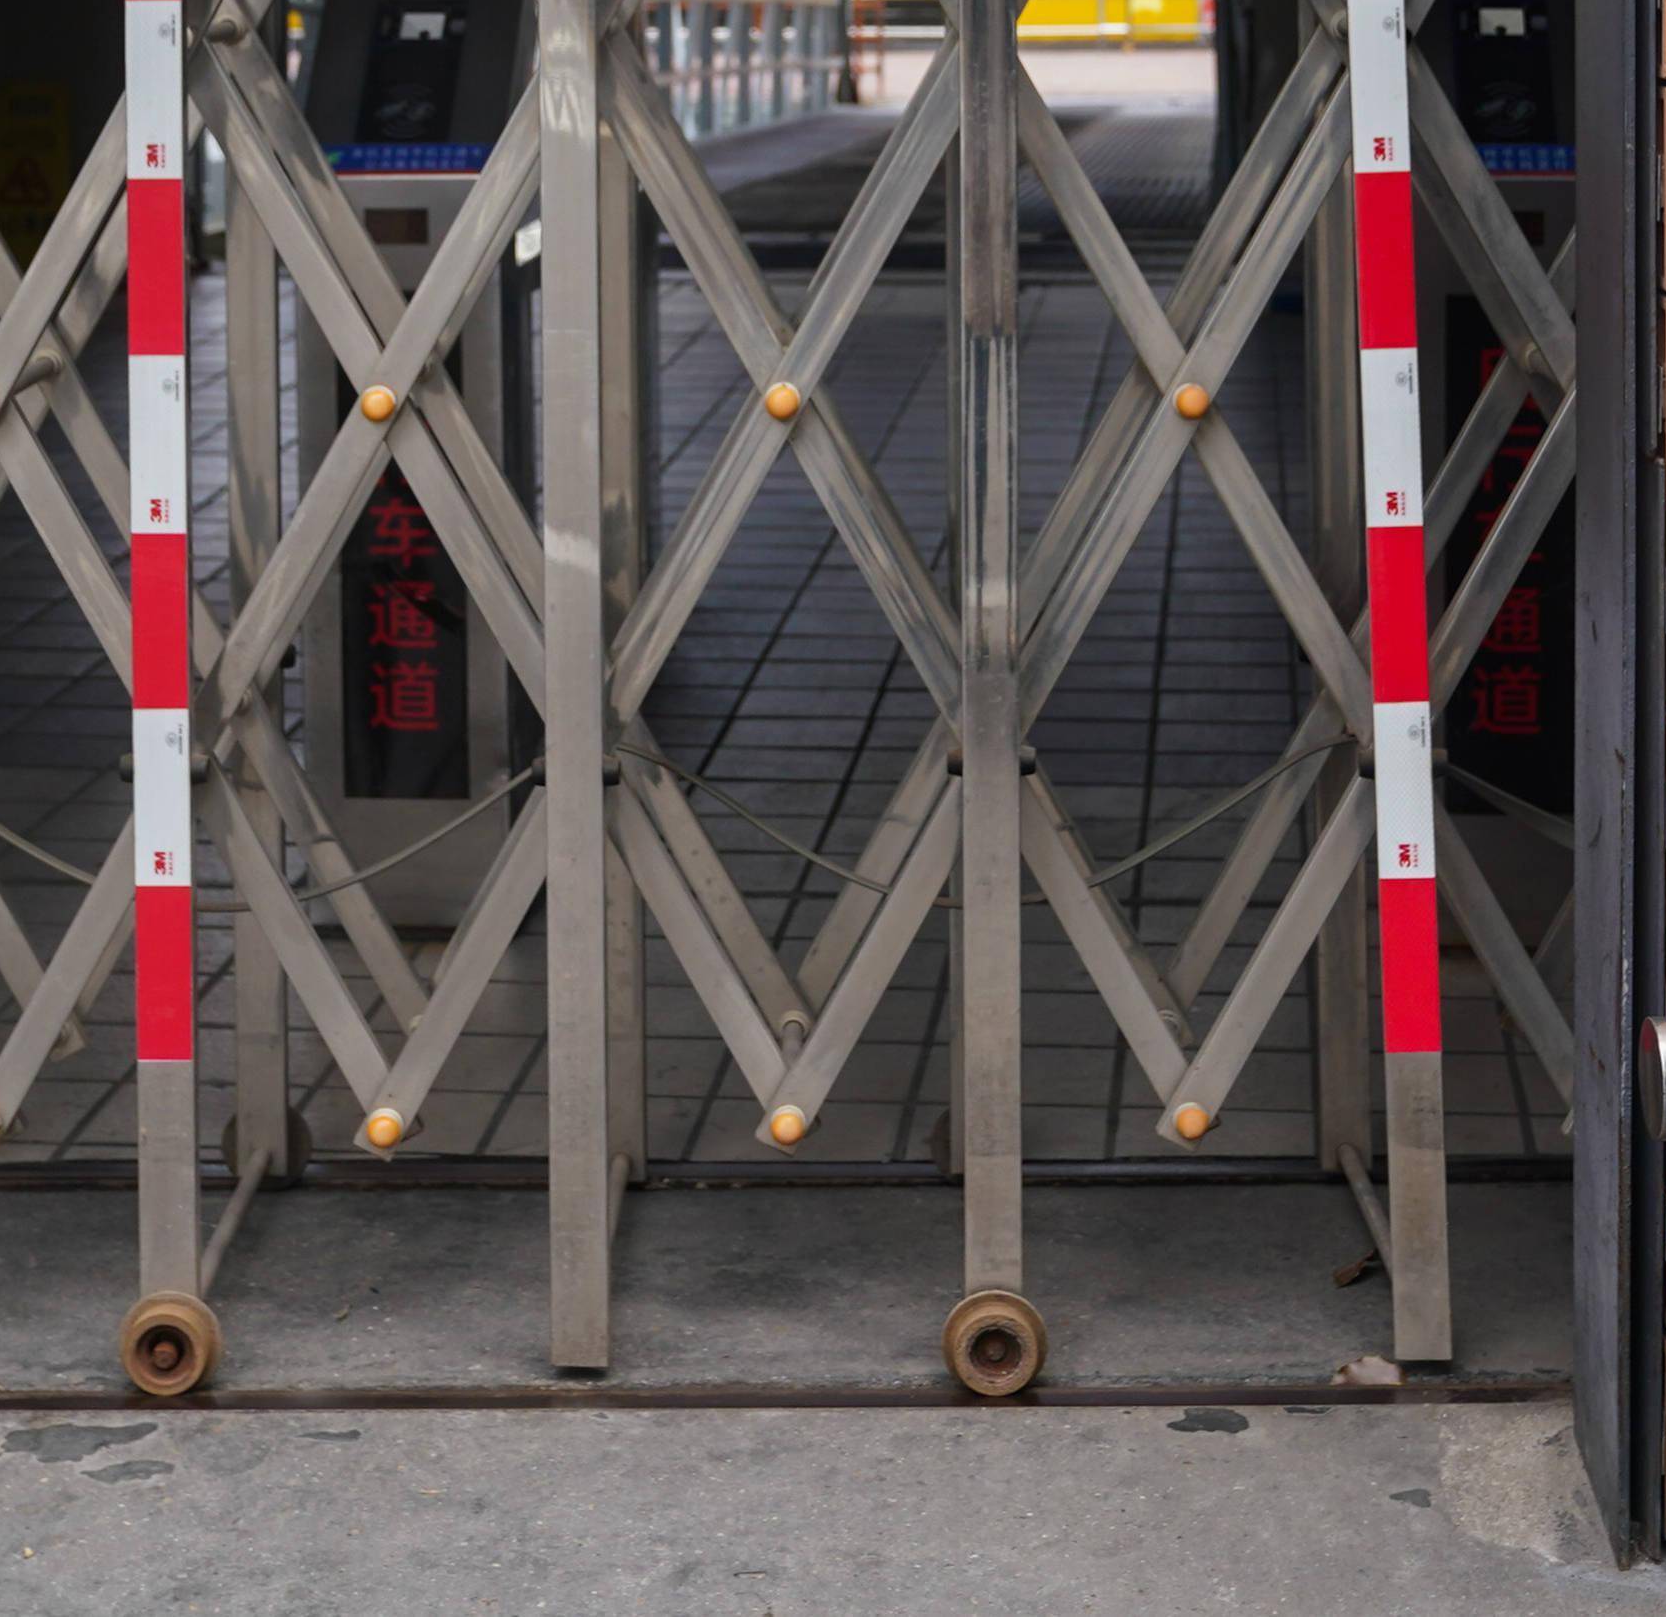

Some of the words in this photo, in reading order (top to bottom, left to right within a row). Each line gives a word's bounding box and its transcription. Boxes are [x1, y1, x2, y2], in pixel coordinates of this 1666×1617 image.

[146, 144, 158, 165] 3M
[1373, 138, 1386, 159] 3M
[150, 499, 162, 521] 3M
[1386, 491, 1399, 514] 3M
[367, 474, 441, 732] 车通道
[154, 851, 166, 873] 3M
[1399, 843, 1411, 866] 3M
